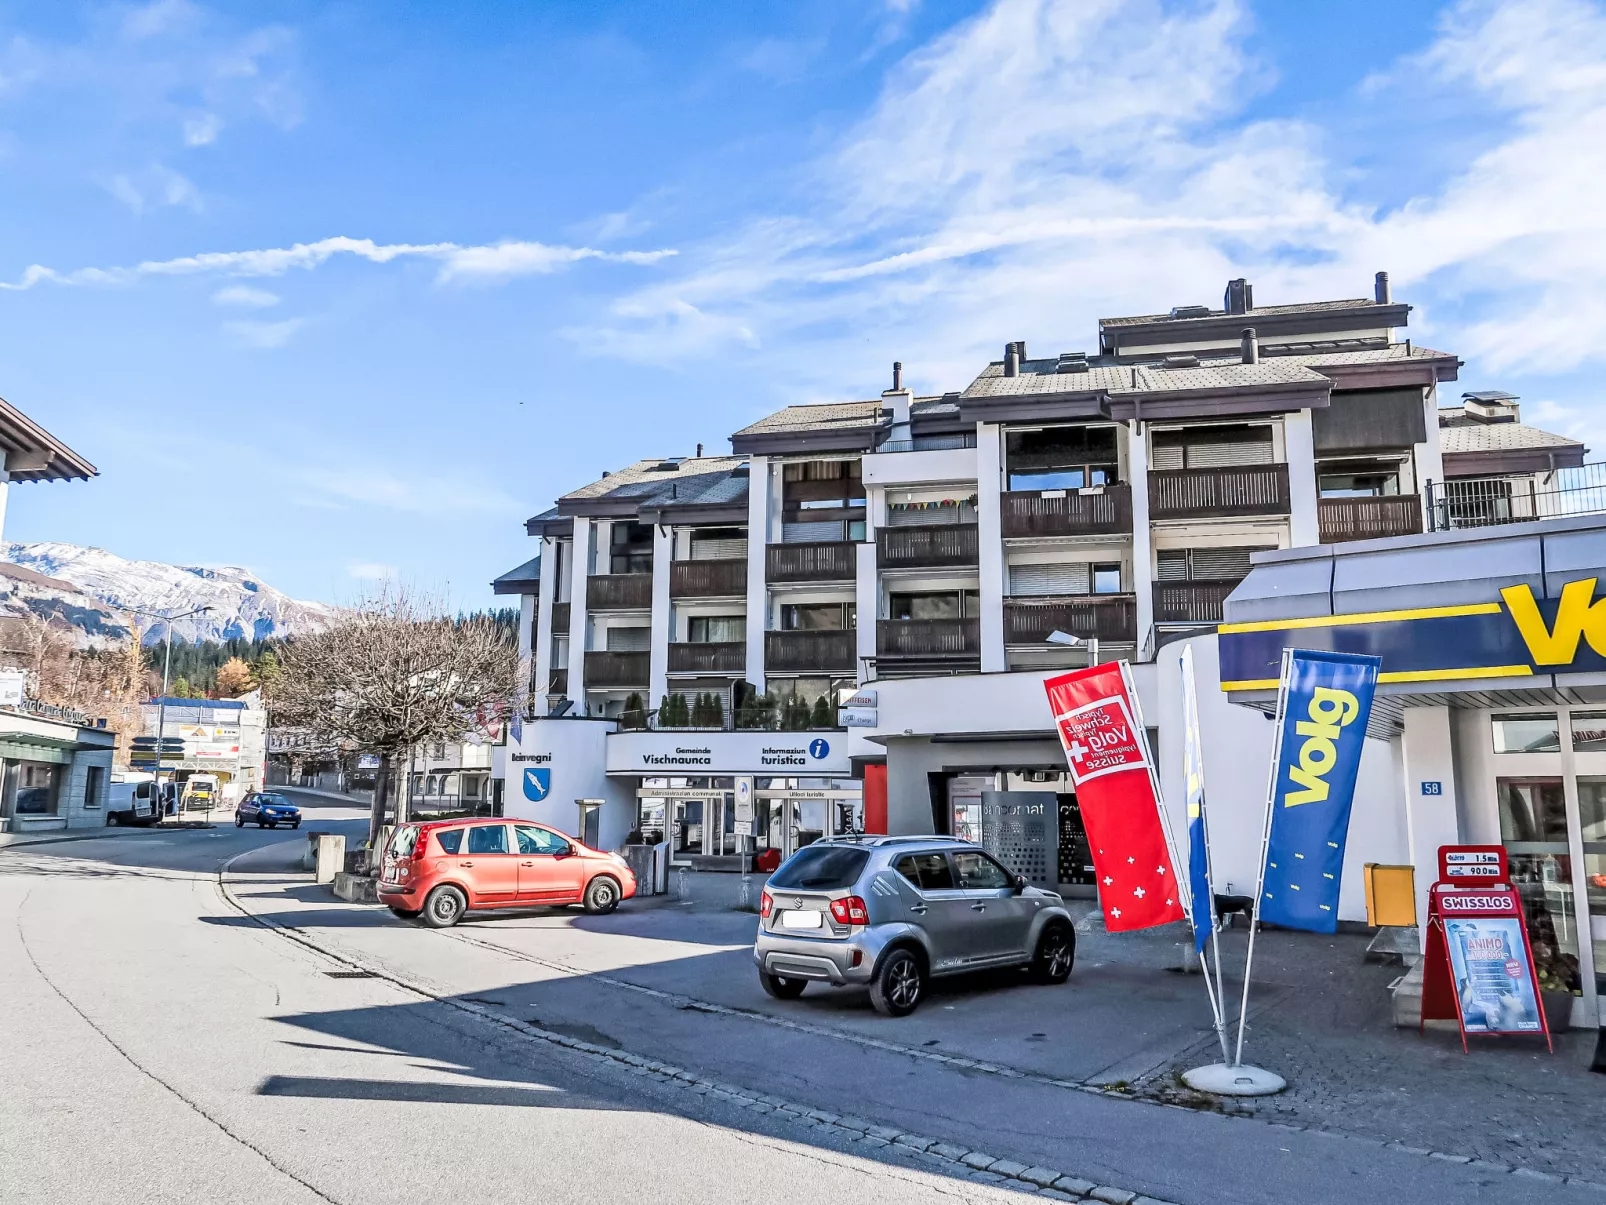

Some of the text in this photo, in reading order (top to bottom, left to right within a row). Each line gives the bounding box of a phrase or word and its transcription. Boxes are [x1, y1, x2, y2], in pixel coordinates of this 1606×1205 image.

[1500, 577, 1606, 666] V
[1284, 686, 1359, 808] Volg
[643, 754, 711, 764] Vischnaunca
[761, 755, 806, 765] turistica
[1425, 783, 1439, 794] 58
[1443, 898, 1512, 909] SWISSLOS
[1467, 938, 1503, 951] ANIMO
